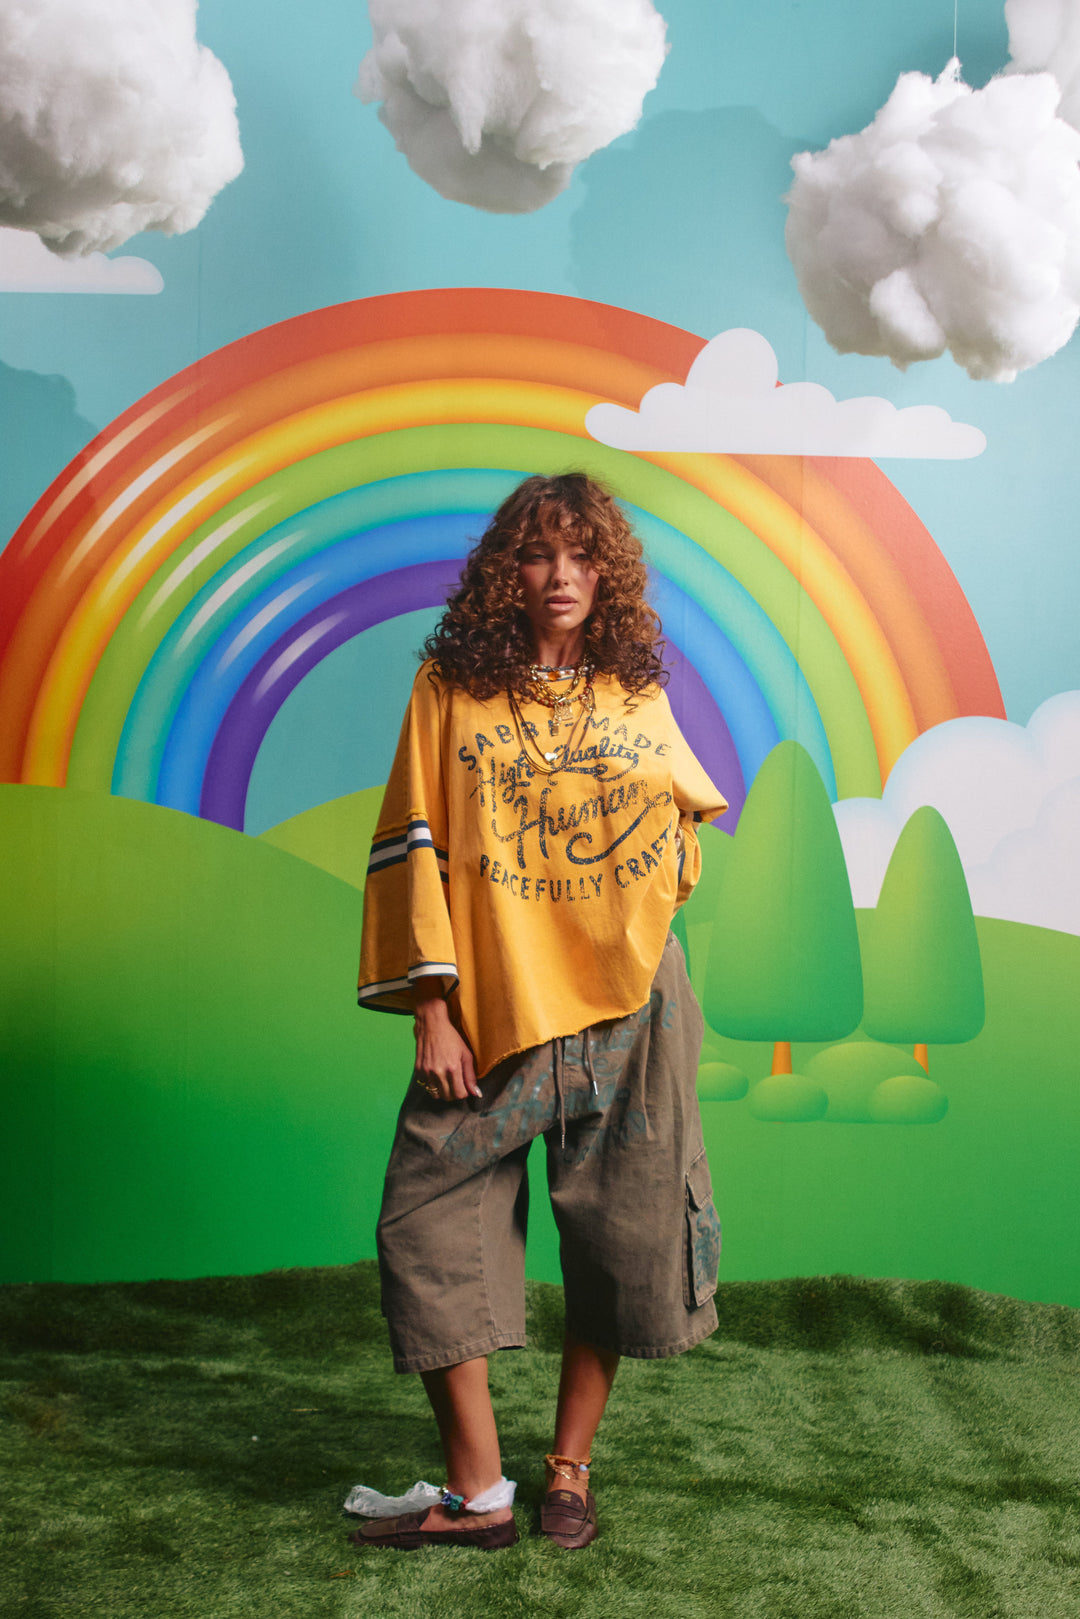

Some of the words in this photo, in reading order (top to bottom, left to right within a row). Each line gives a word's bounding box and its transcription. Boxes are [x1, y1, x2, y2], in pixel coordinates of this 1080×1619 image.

[469, 749, 536, 813] High
[491, 780, 672, 869] Human
[479, 854, 604, 903] PEACEFULLY
